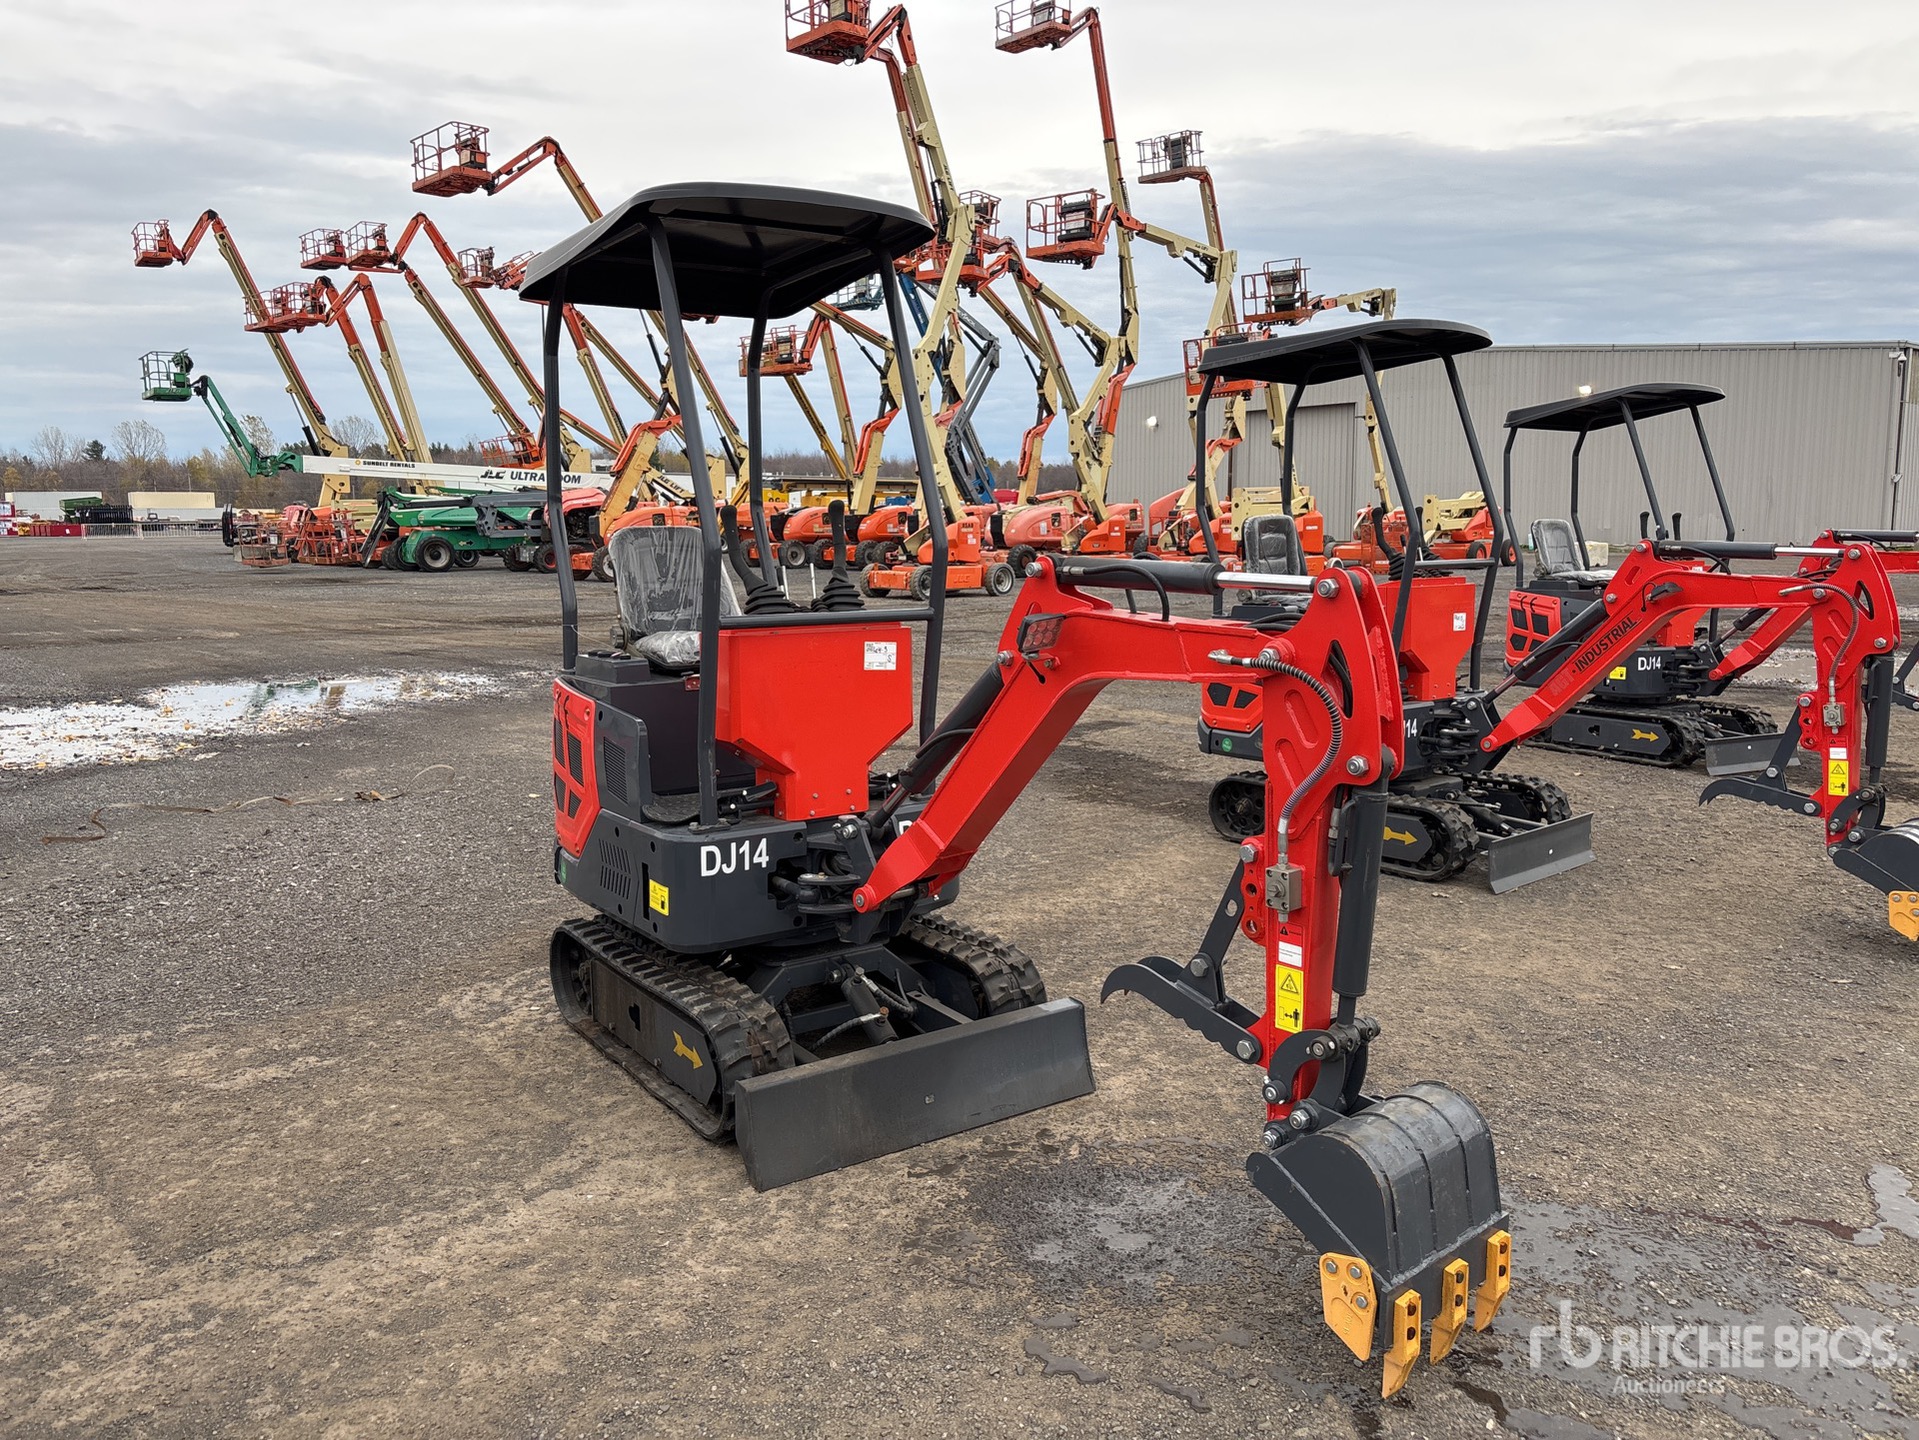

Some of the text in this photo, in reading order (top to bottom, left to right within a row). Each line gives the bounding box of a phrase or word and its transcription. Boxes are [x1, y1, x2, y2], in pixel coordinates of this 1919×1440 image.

[480, 469, 506, 480] JLG
[657, 475, 685, 494] JLG LIFT
[1575, 616, 1638, 671] INDUSTRIAL
[1637, 655, 1662, 671] DJ14
[700, 837, 770, 878] DJ14
